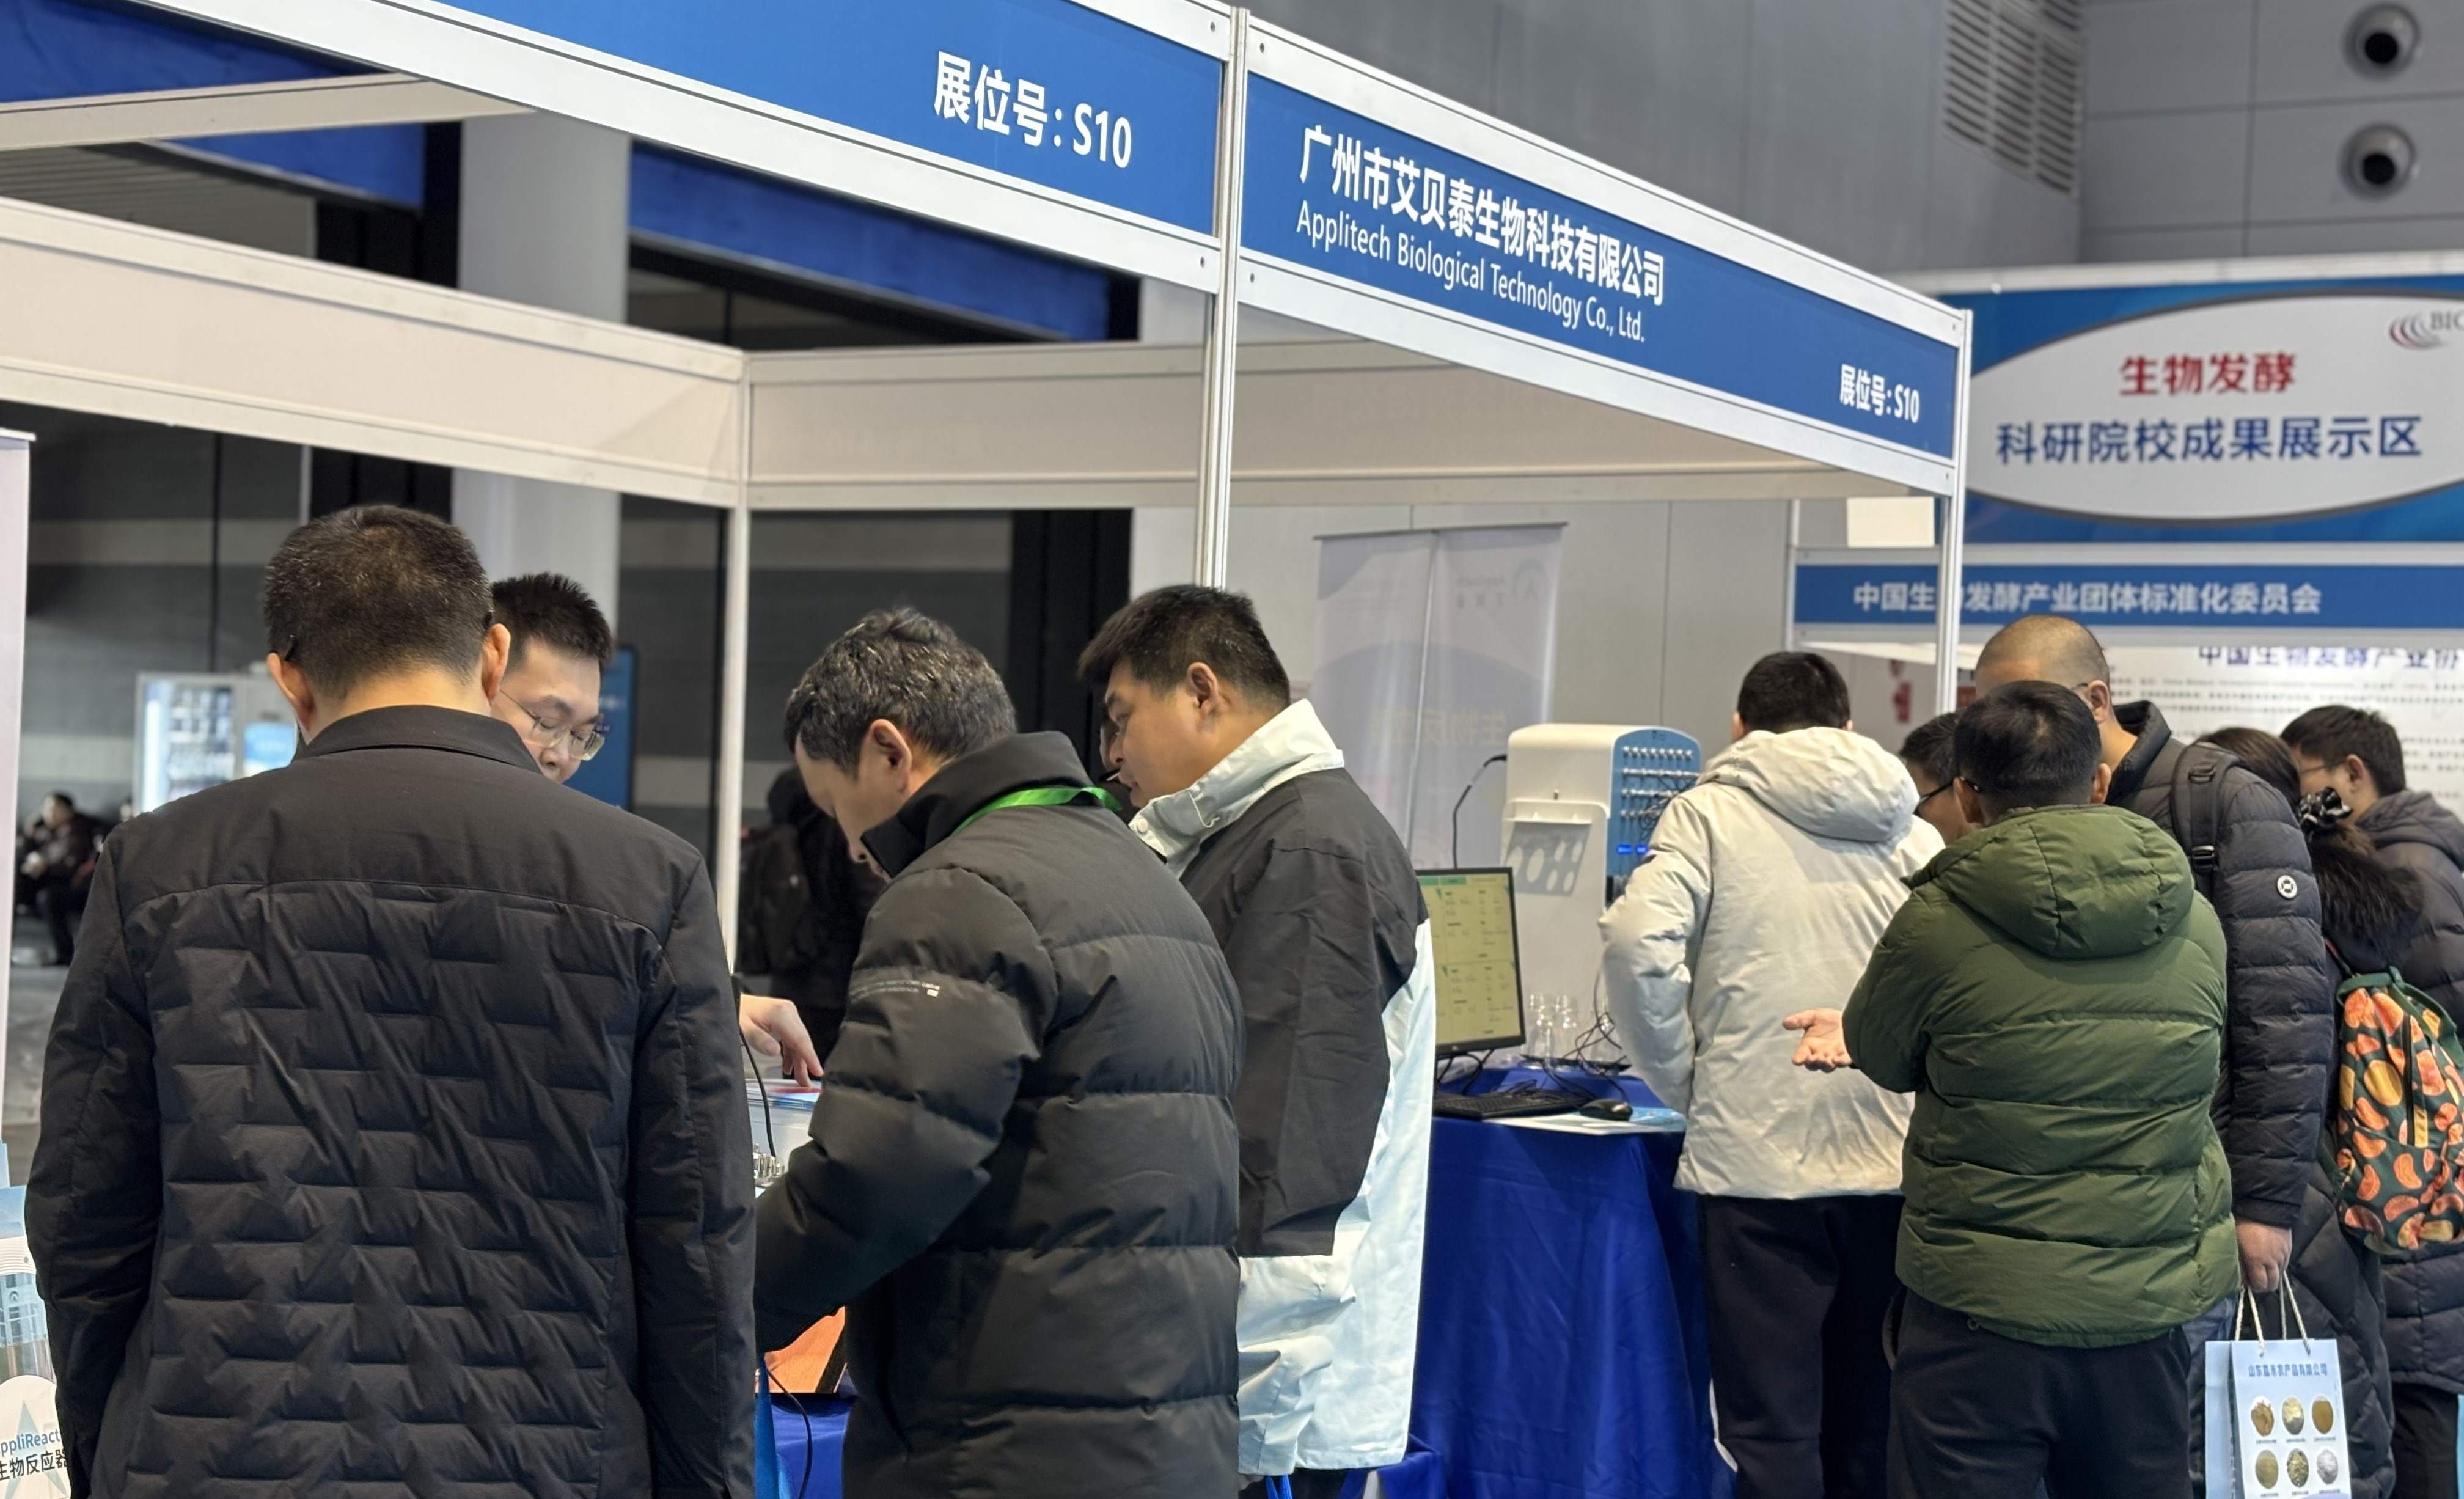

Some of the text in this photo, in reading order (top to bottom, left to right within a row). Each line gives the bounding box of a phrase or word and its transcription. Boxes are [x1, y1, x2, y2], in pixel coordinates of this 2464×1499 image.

[1300, 125, 1664, 306] 广州市艾贝泰生物科技有限公司
[1296, 200, 1645, 342] Applitech Biological Technology Co., Ltd.
[2119, 353, 2295, 395] 生物发酵
[1997, 417, 2422, 464] 科研院校成果展示区
[1854, 582, 2322, 615] 中国生发酵产业团体标准化委员会
[0, 1429, 61, 1457] ppliReact
